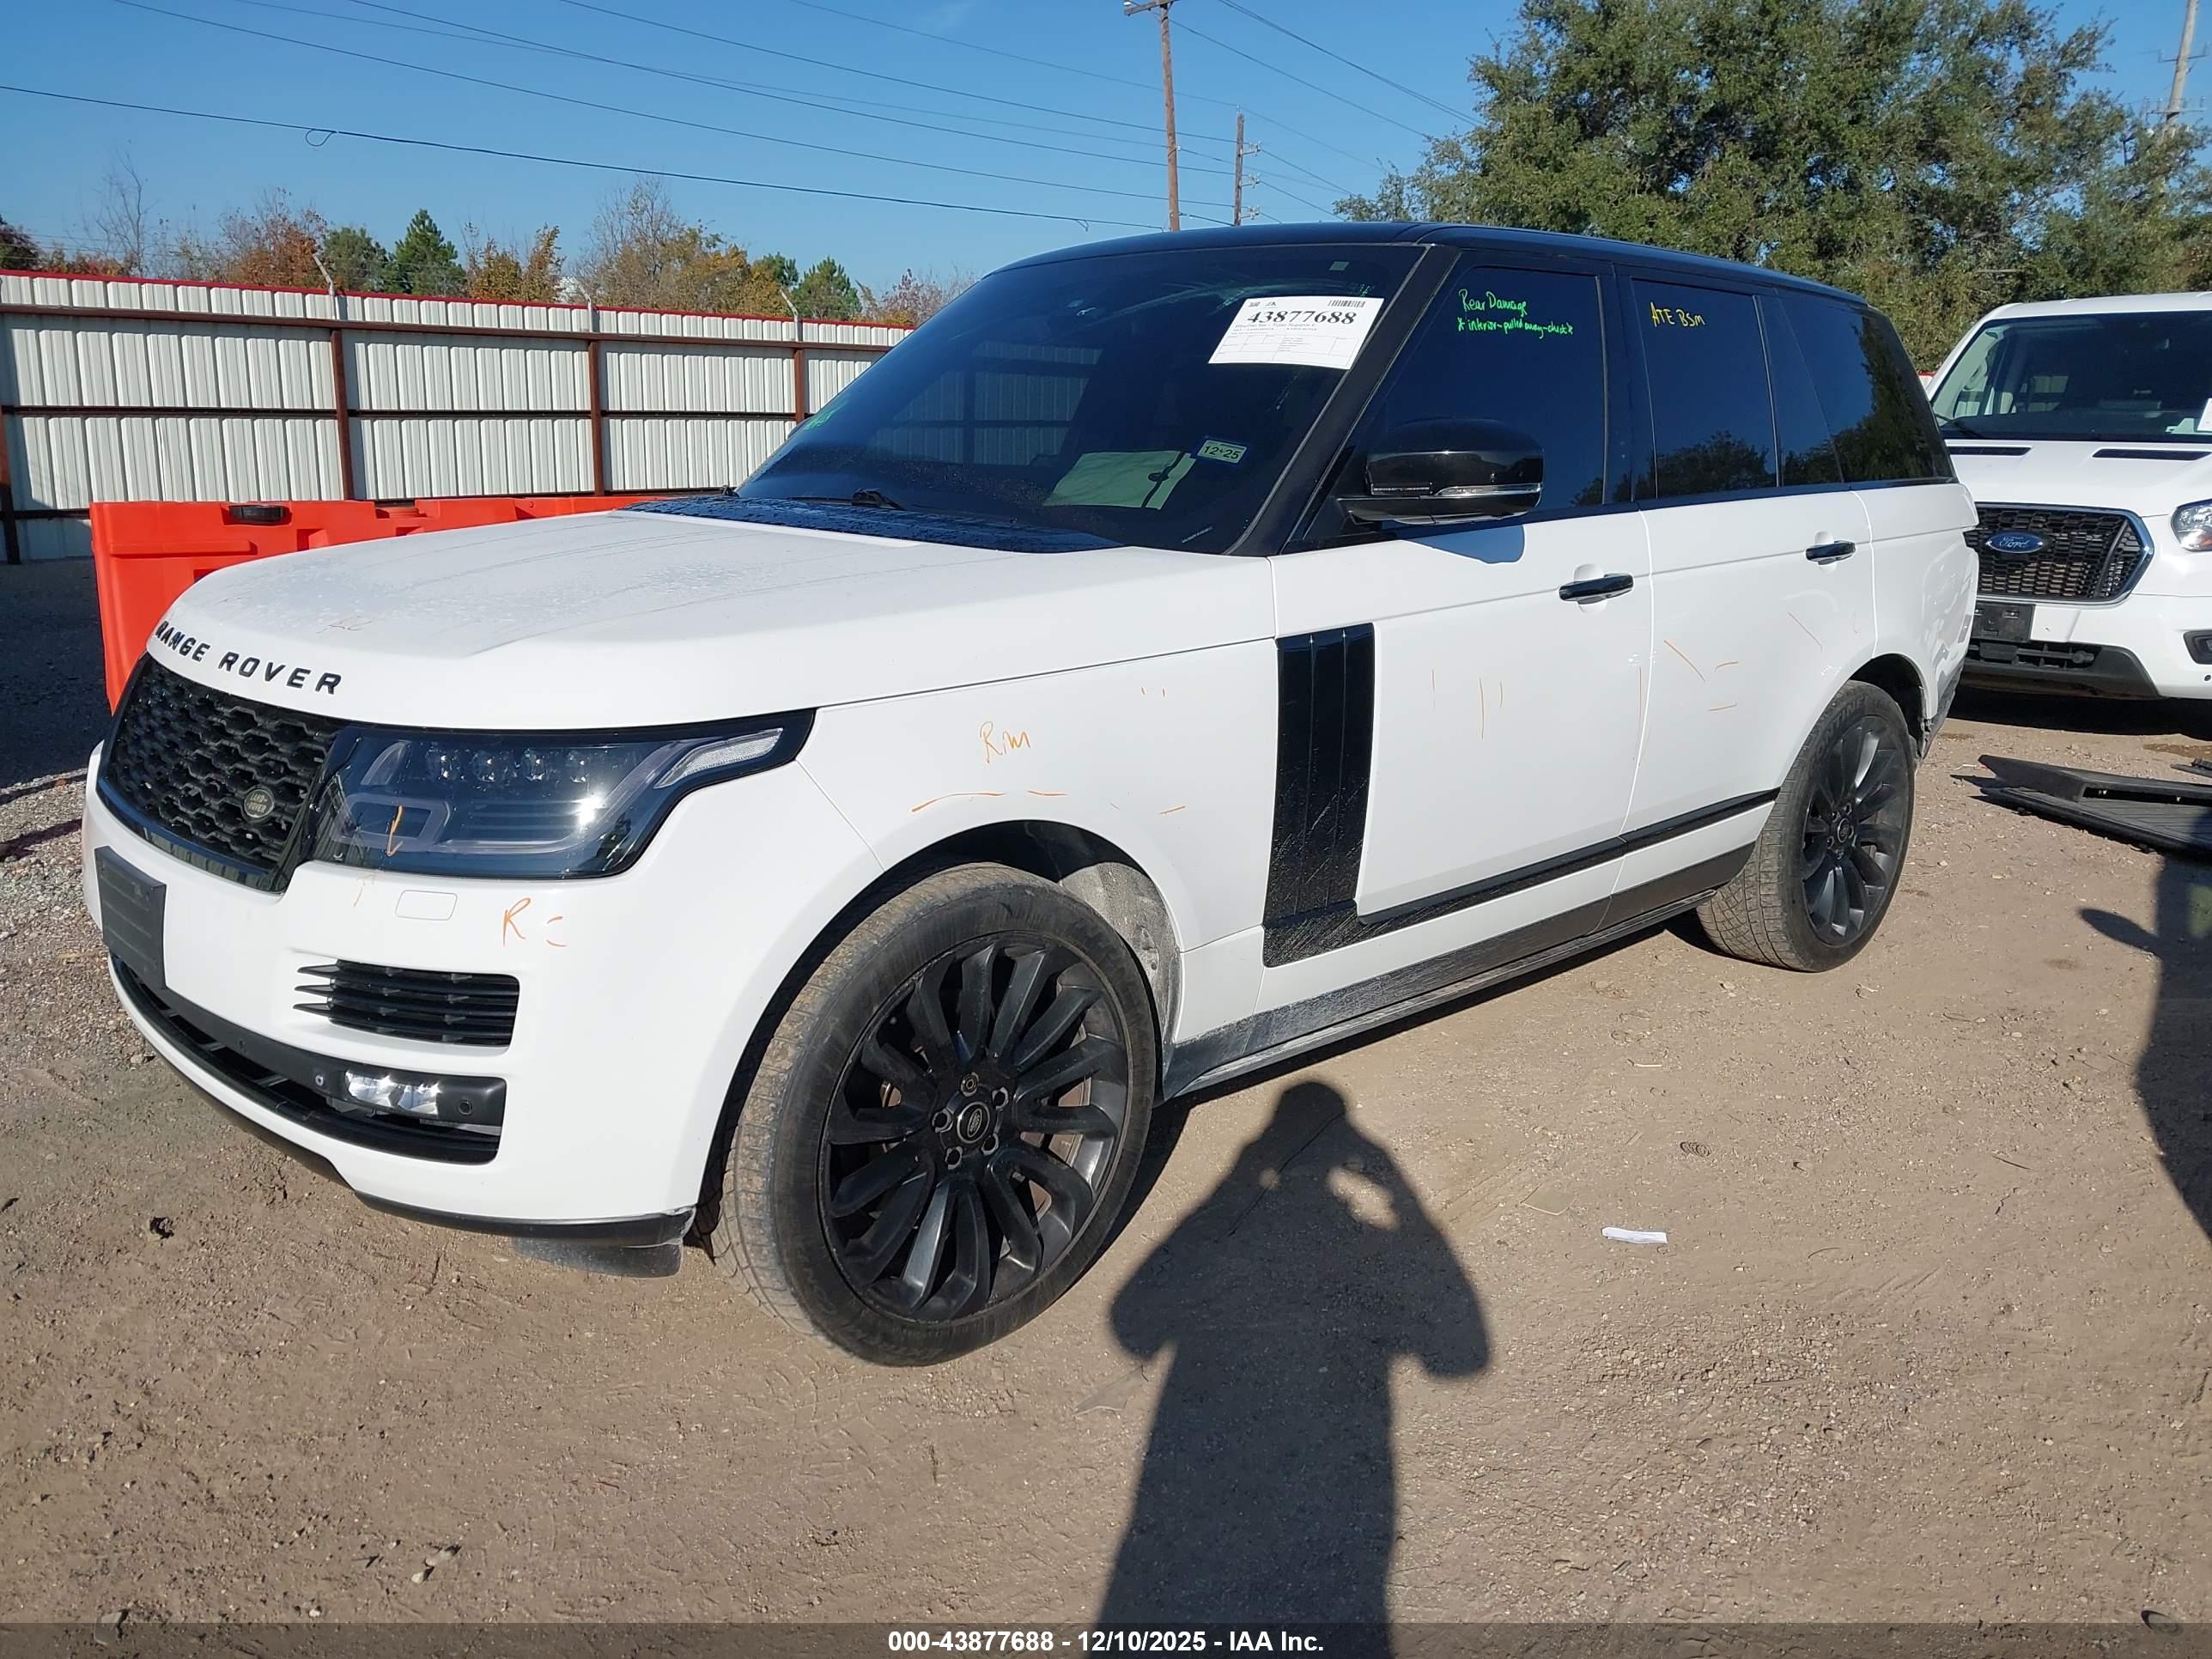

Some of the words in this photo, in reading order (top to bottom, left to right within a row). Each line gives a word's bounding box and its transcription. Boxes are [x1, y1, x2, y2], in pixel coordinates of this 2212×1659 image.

[1459, 289, 1486, 312] Rear
[1486, 291, 1528, 317] Damage
[1650, 301, 1675, 327] ATE
[1247, 310, 1357, 325] 43877688
[1204, 446, 1219, 455] 12
[1223, 449, 1242, 459] 25
[155, 621, 210, 662] RANGE
[218, 652, 342, 695] ROVER
